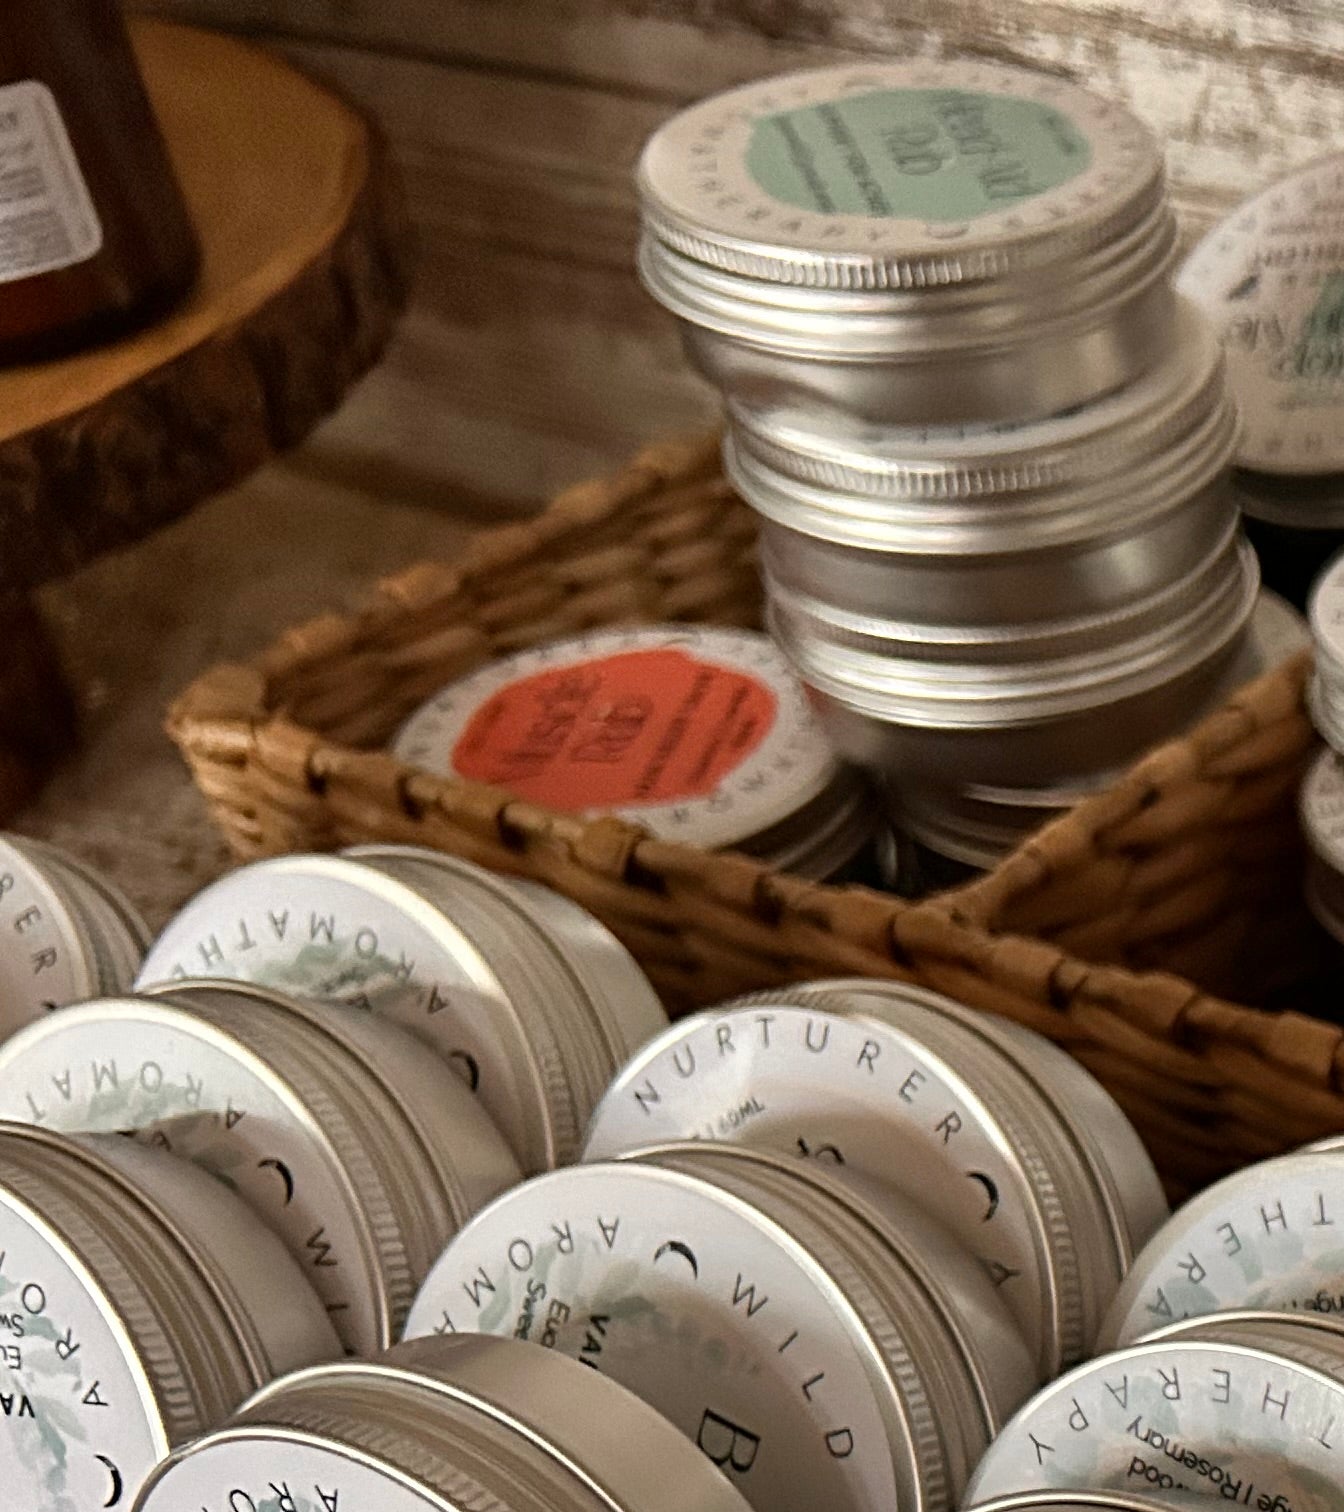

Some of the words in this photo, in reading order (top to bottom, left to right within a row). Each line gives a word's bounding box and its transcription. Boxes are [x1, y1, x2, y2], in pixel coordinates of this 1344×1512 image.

[634, 1015, 964, 1144] NURTURER
[732, 1272, 855, 1459] WILD
[1125, 1414, 1240, 1499] Rosemary
